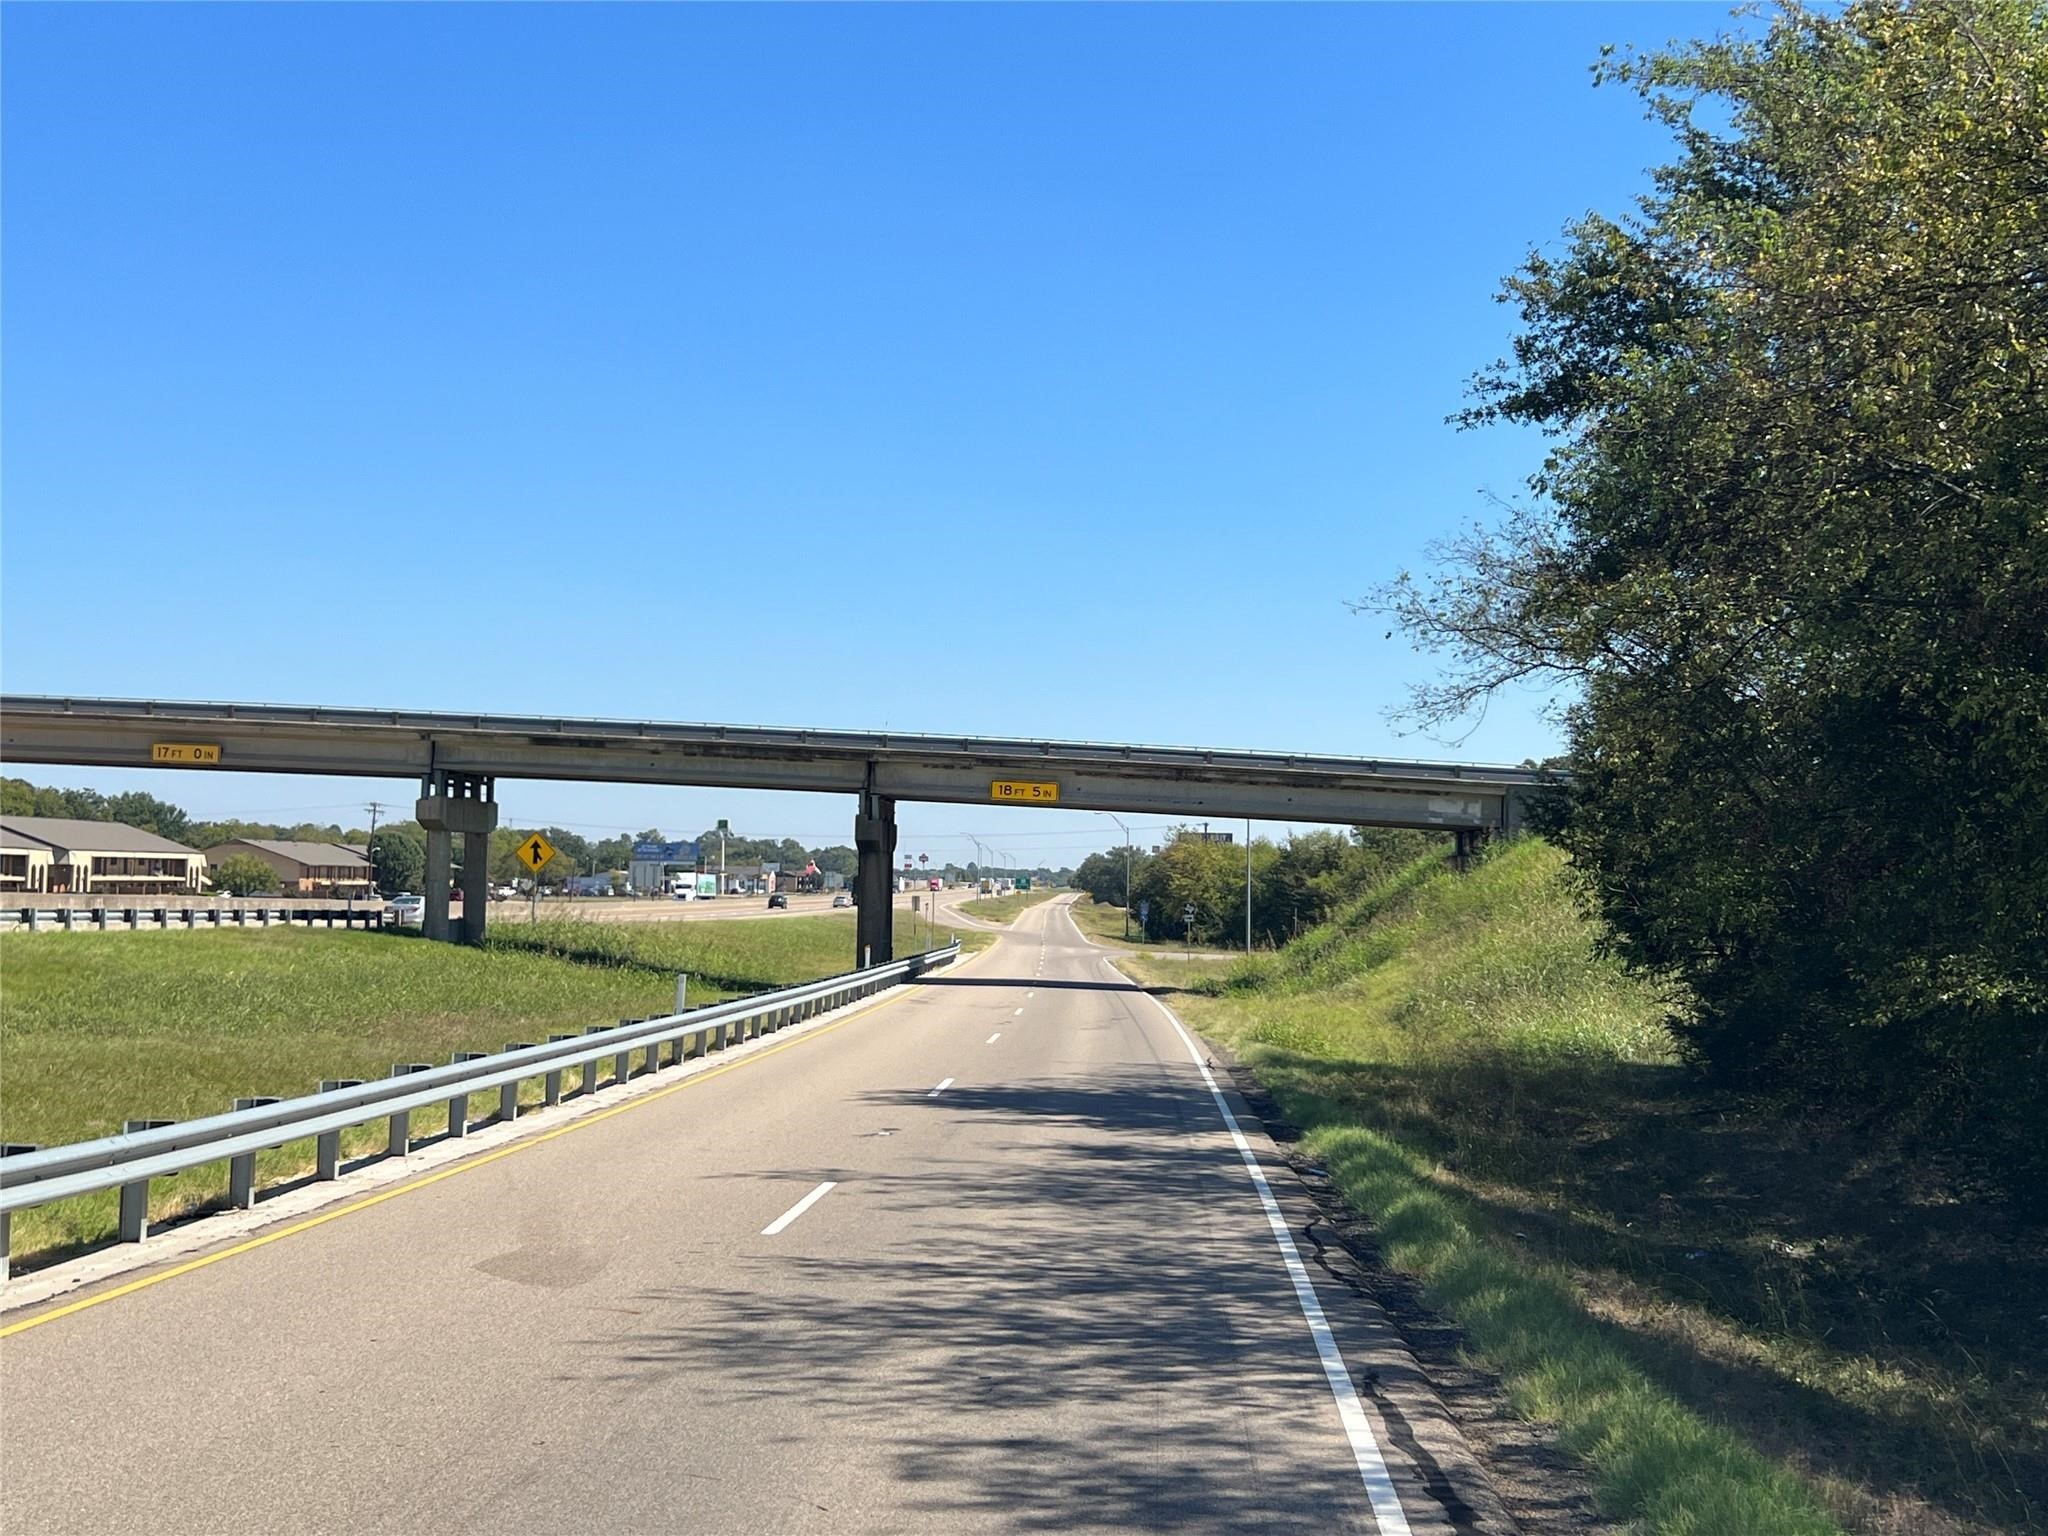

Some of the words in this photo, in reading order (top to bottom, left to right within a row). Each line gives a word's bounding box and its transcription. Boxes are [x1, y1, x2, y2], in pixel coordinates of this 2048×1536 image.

[158, 747, 169, 758] 17
[171, 750, 182, 758] FT
[194, 748, 202, 759] 0
[204, 751, 213, 759] IN
[999, 785, 1012, 796] 18
[1014, 788, 1025, 796] FT
[1033, 786, 1041, 797] 5
[1043, 790, 1052, 798] IN
